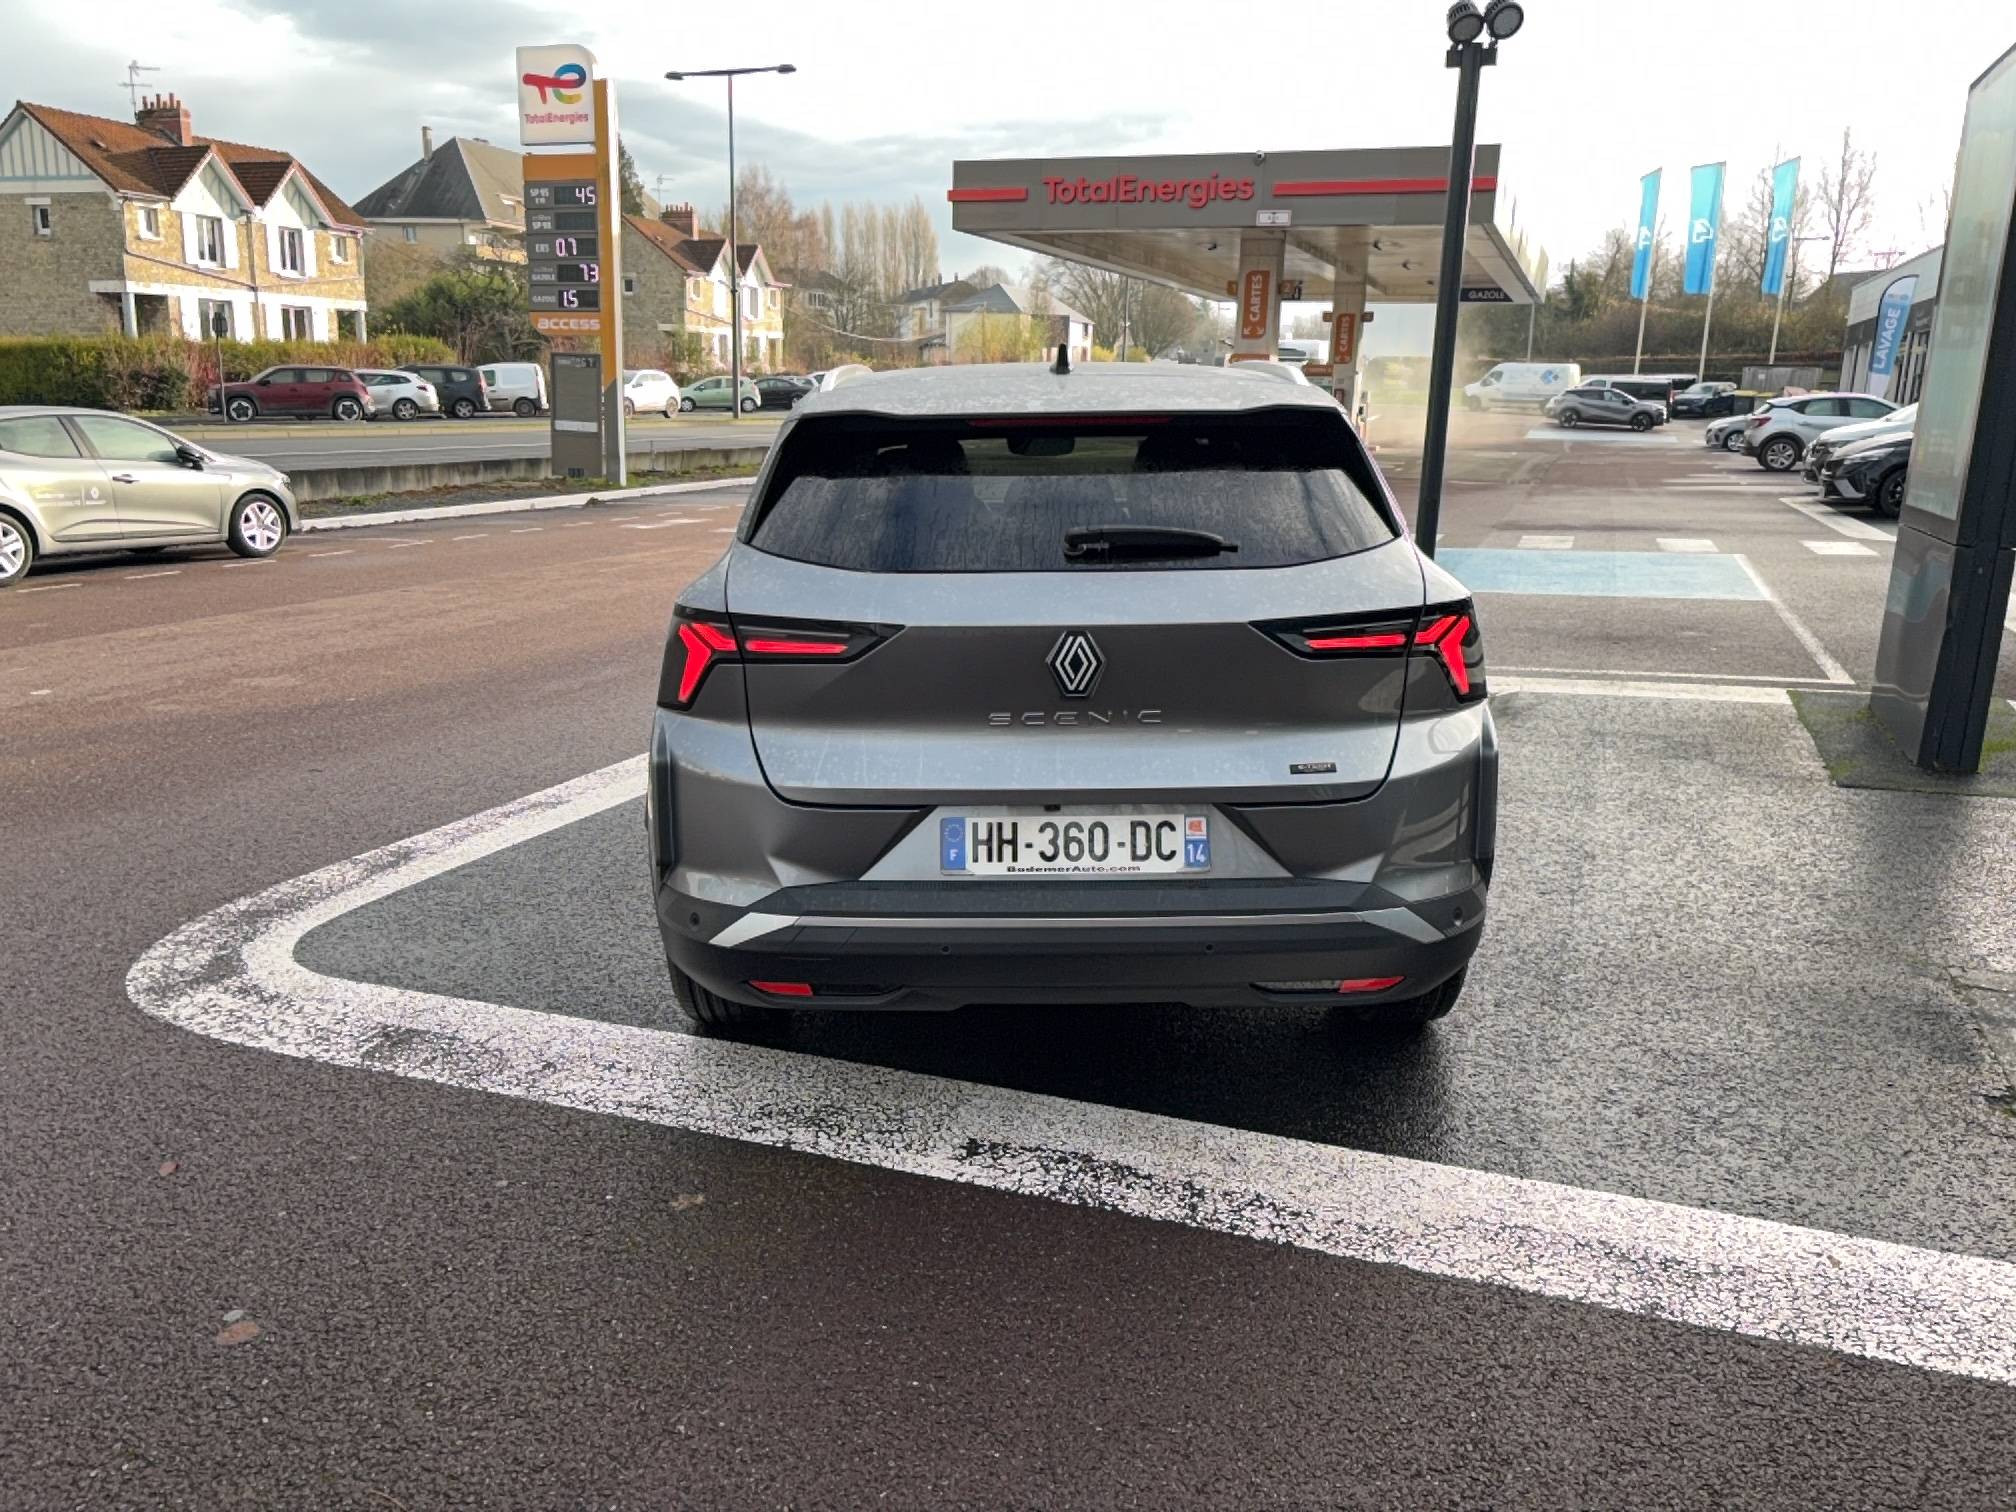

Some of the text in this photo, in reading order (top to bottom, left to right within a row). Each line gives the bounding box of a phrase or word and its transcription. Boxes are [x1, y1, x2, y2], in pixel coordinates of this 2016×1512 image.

[524, 112, 589, 125] TotalEnergies
[575, 186, 596, 205] 45
[1043, 171, 1255, 209] TotalEnergies
[1249, 274, 1263, 322] CARTES
[1872, 307, 1902, 369] LAVAGE
[988, 709, 1163, 726] SCENIC
[972, 820, 1177, 863] HH-360-DC
[949, 850, 959, 861] F
[1187, 843, 1207, 864] 14
